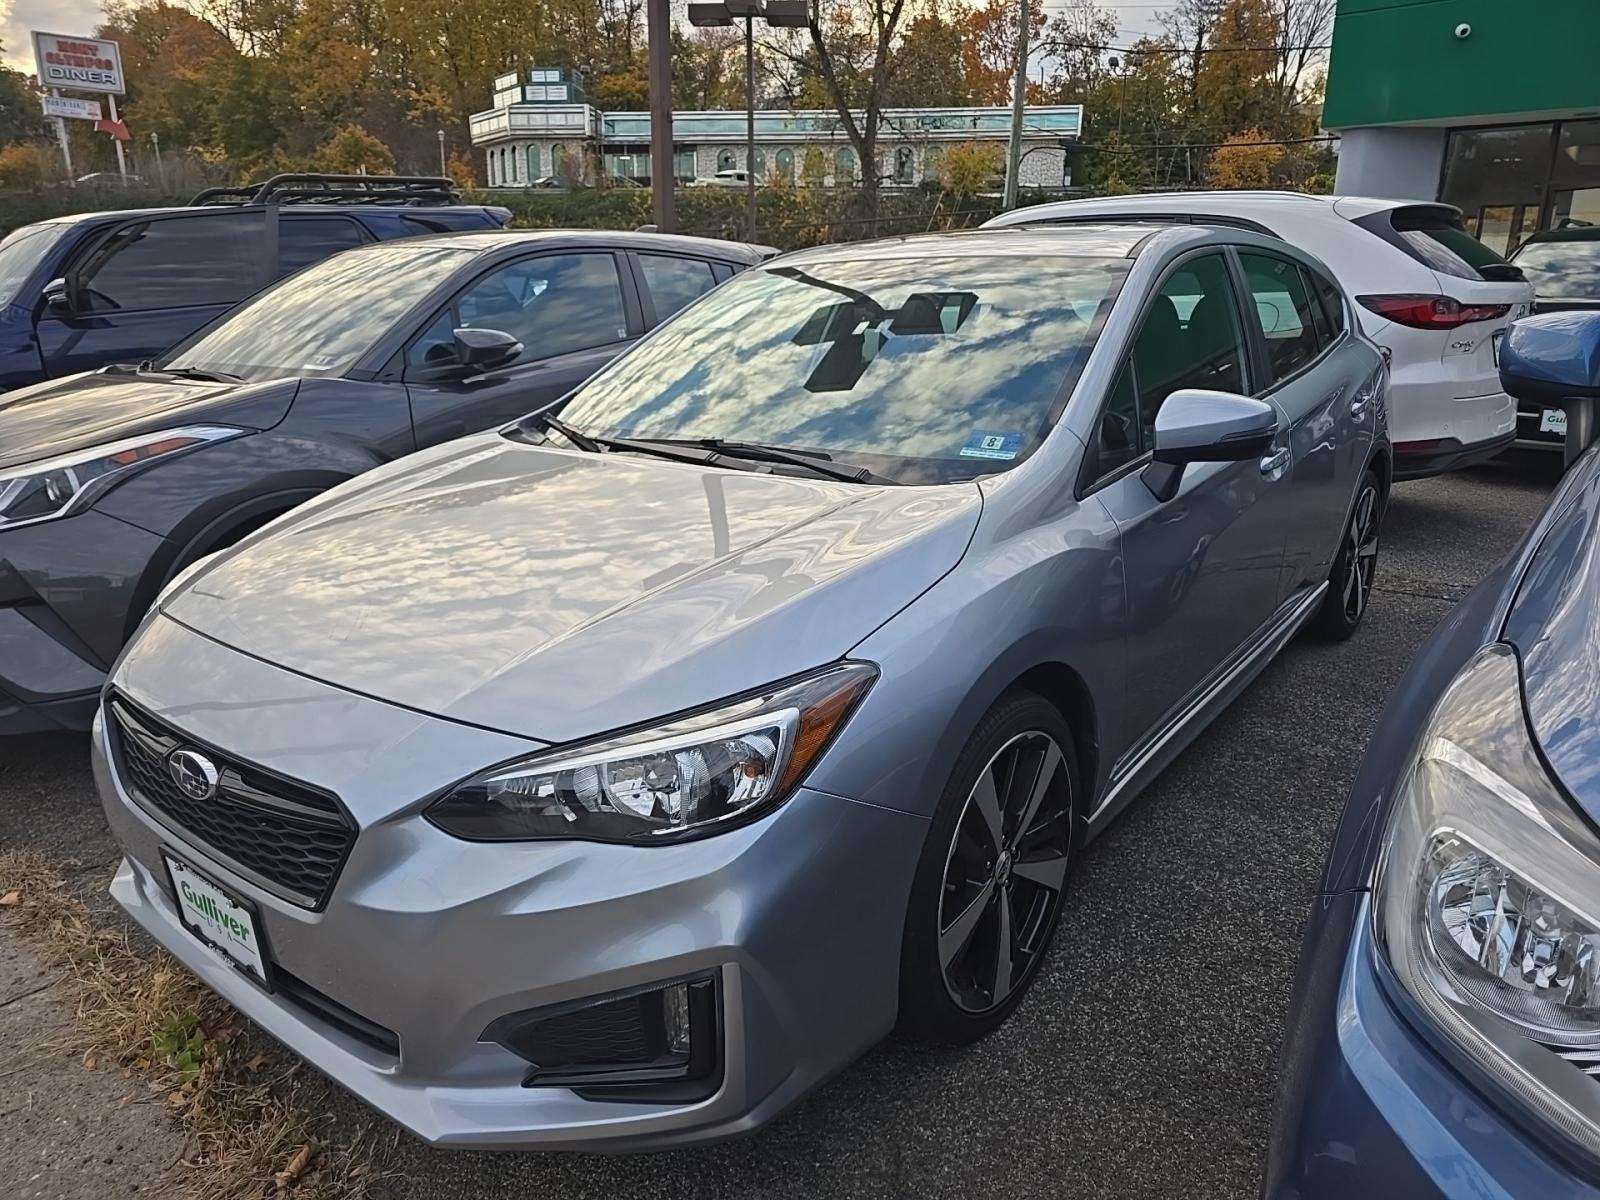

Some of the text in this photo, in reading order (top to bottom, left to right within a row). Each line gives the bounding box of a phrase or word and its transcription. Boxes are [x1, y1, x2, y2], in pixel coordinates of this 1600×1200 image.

[50, 67, 116, 85] DINER
[987, 437, 997, 447] 8
[181, 880, 250, 941] Gulliver
